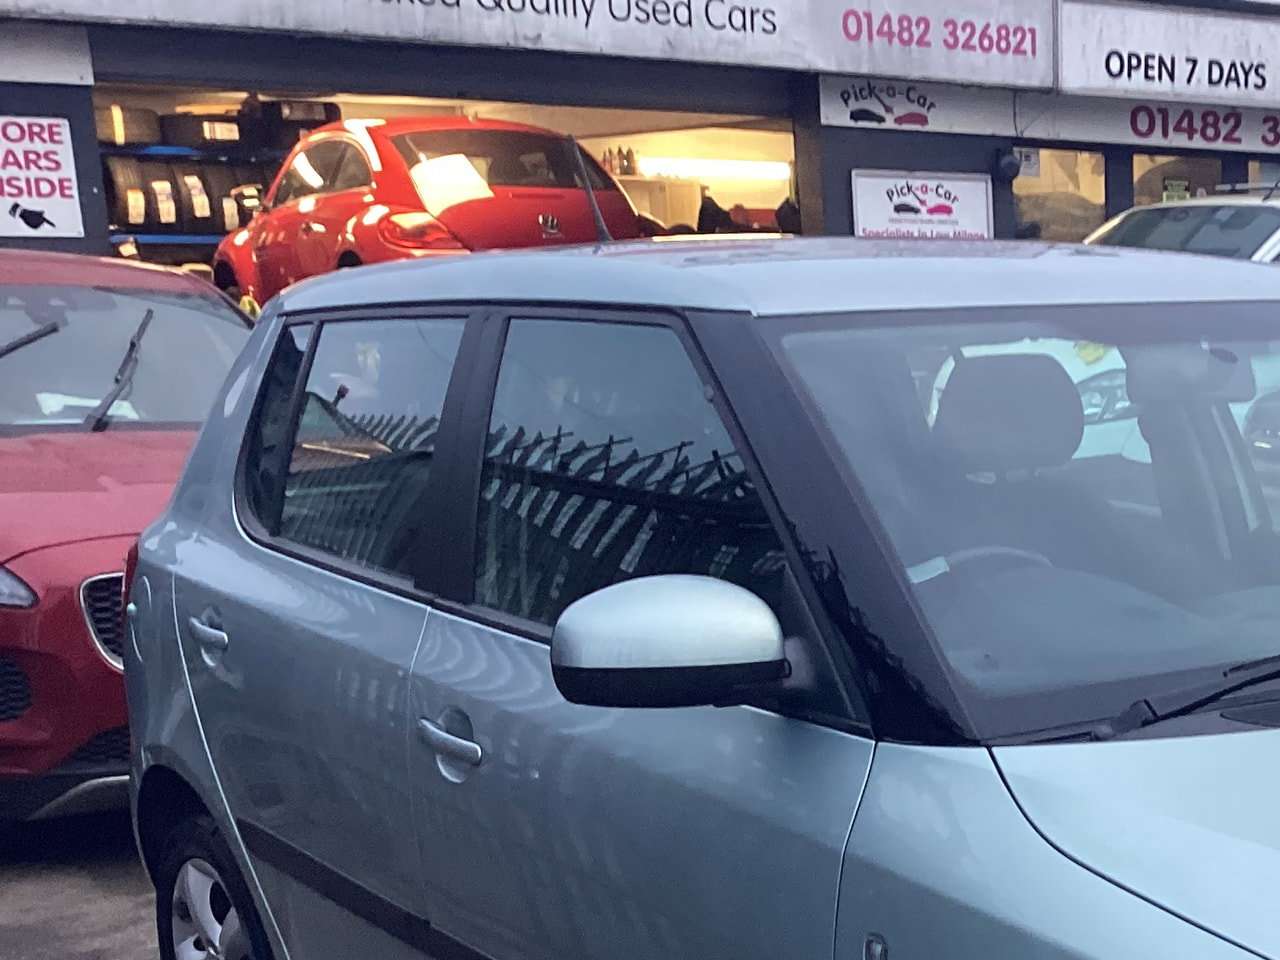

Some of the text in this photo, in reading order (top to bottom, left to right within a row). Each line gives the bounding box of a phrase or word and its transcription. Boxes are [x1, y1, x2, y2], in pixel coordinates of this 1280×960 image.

[608, 0, 693, 28] Used
[704, 4, 777, 35] Cars
[842, 9, 1037, 58] 01482 326821
[1105, 51, 1267, 90] OPEN 7 DAYS
[0, 121, 63, 144] ORE
[1130, 105, 1242, 144] 01482
[0, 148, 62, 171] ARS
[0, 176, 74, 199] SIDE
